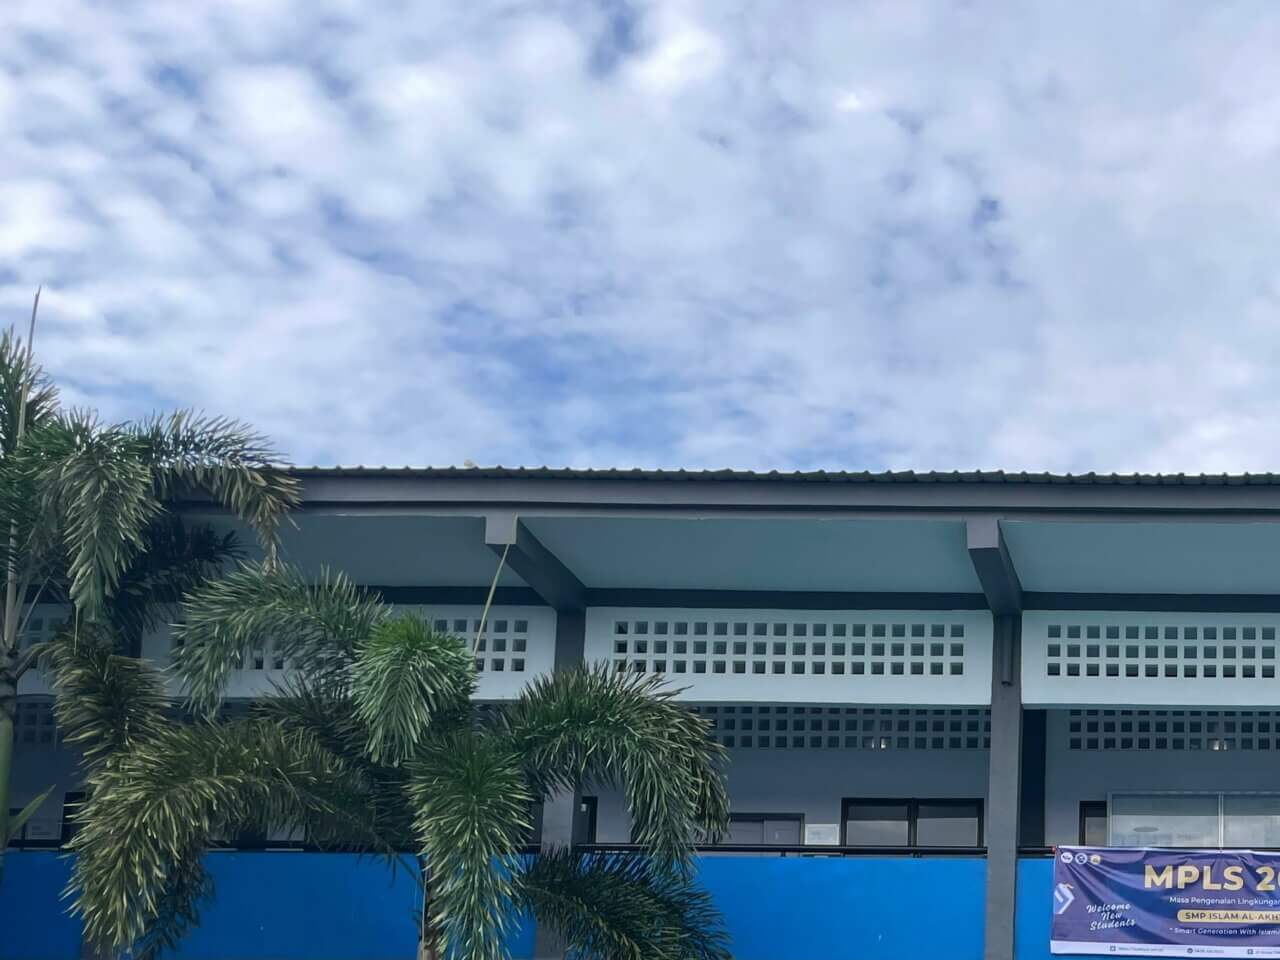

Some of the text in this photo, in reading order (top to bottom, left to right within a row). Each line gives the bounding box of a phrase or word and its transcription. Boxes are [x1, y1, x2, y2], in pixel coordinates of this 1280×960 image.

[1144, 864, 1244, 891] MPLS
[1190, 896, 1236, 907] Pengenalan
[1086, 903, 1131, 913] Welcome
[1101, 911, 1122, 921] New
[1185, 912, 1207, 920] SMP
[1209, 912, 1239, 920] ISLAM
[1090, 919, 1136, 931] Students
[1239, 928, 1257, 936] With
